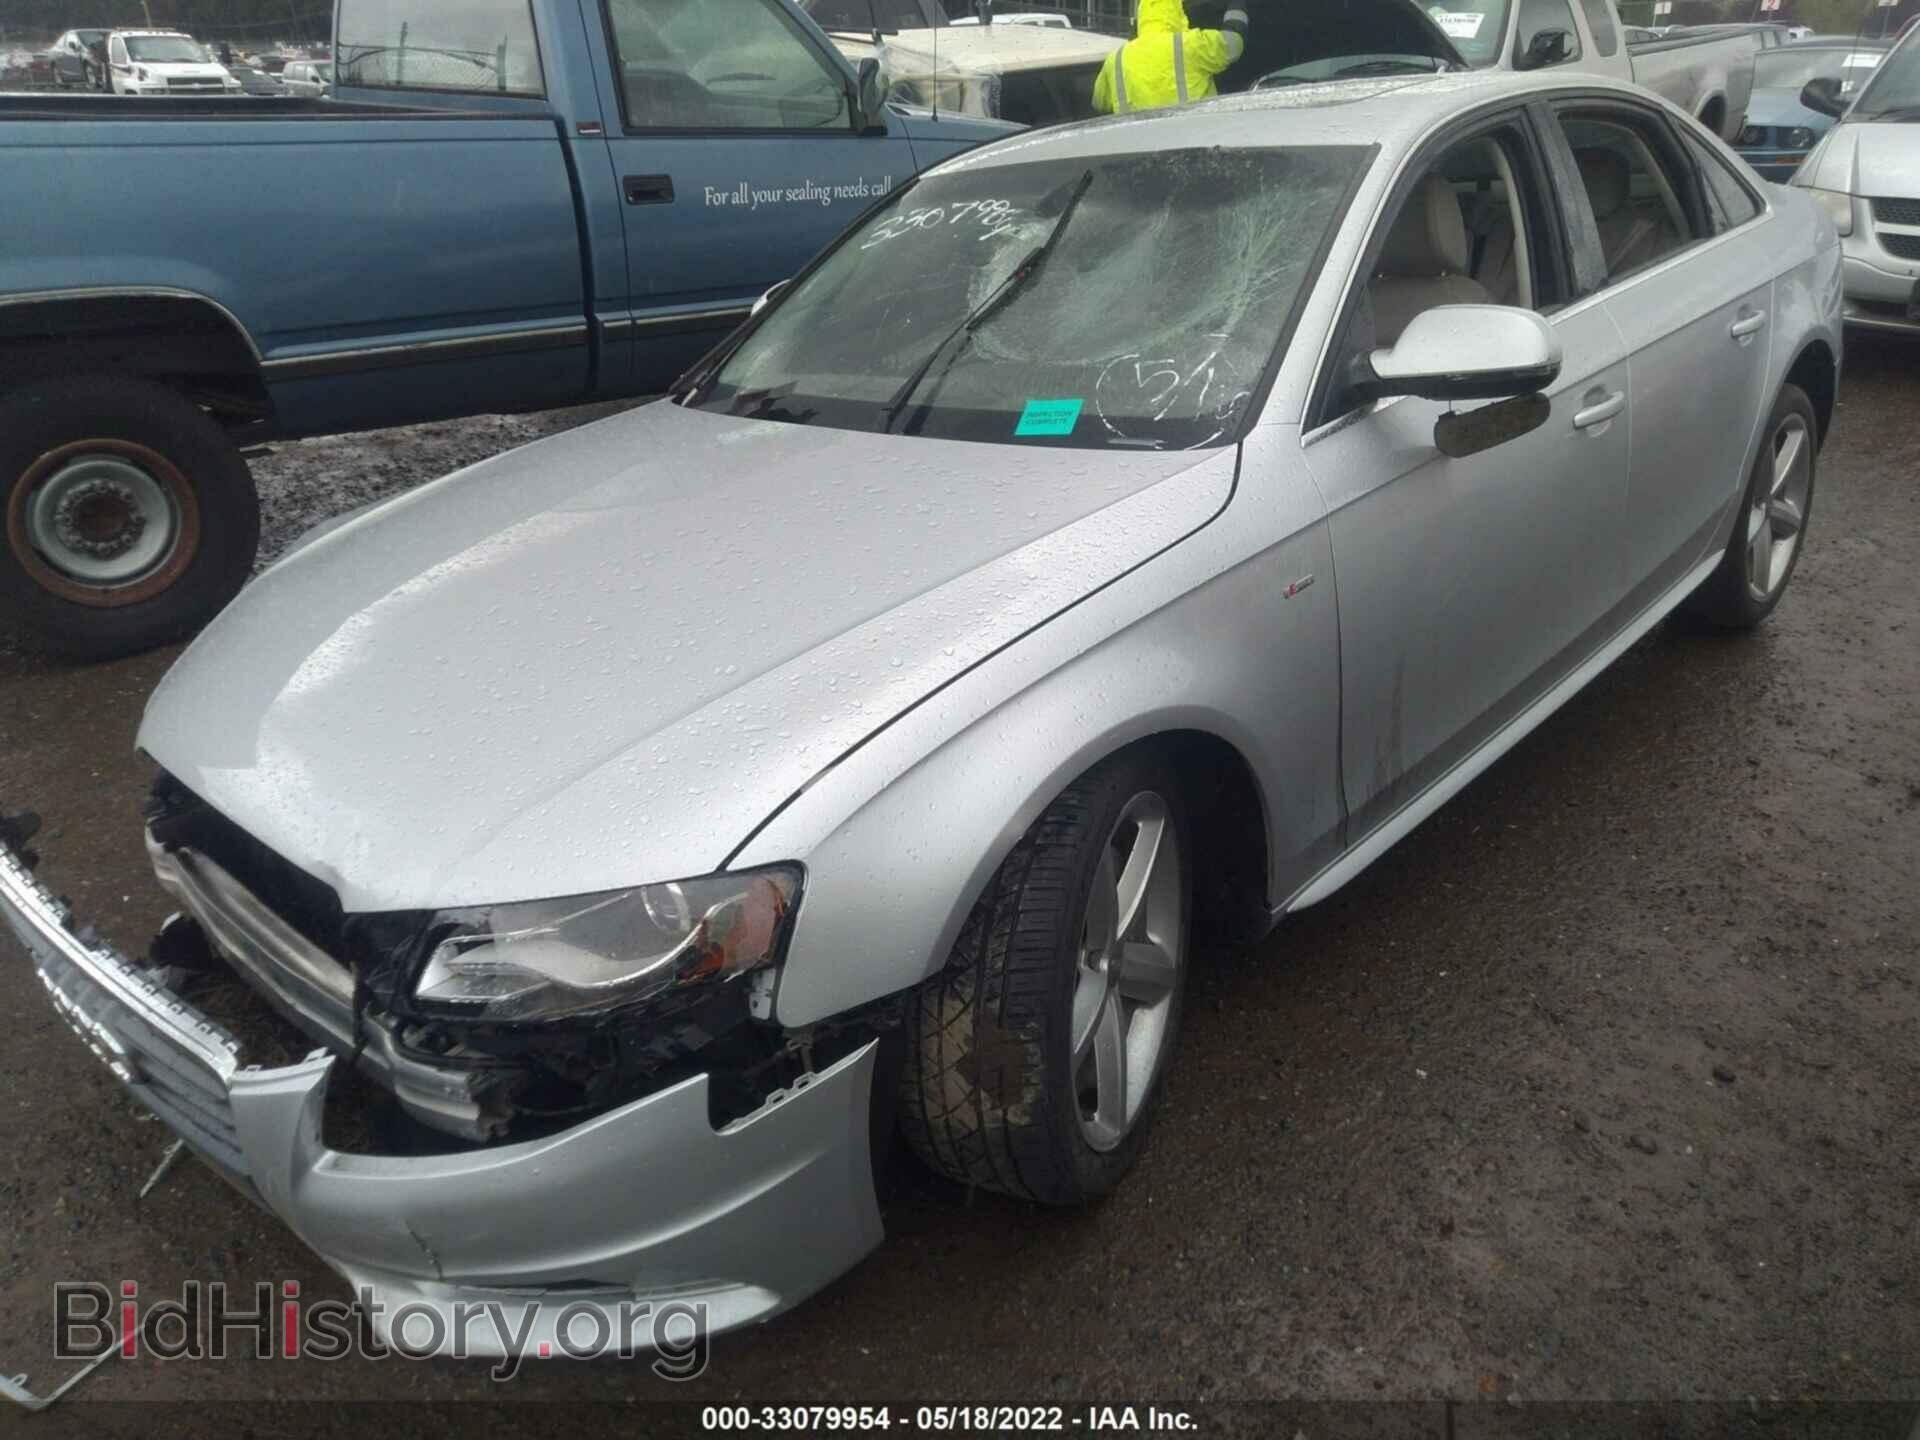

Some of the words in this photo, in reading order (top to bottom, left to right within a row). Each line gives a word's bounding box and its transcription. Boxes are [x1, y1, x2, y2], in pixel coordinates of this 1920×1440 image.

[703, 186, 728, 206] For
[731, 181, 749, 204] all
[751, 189, 784, 211] your
[785, 179, 832, 206] sealing
[833, 176, 869, 198] needs
[871, 175, 892, 196] call
